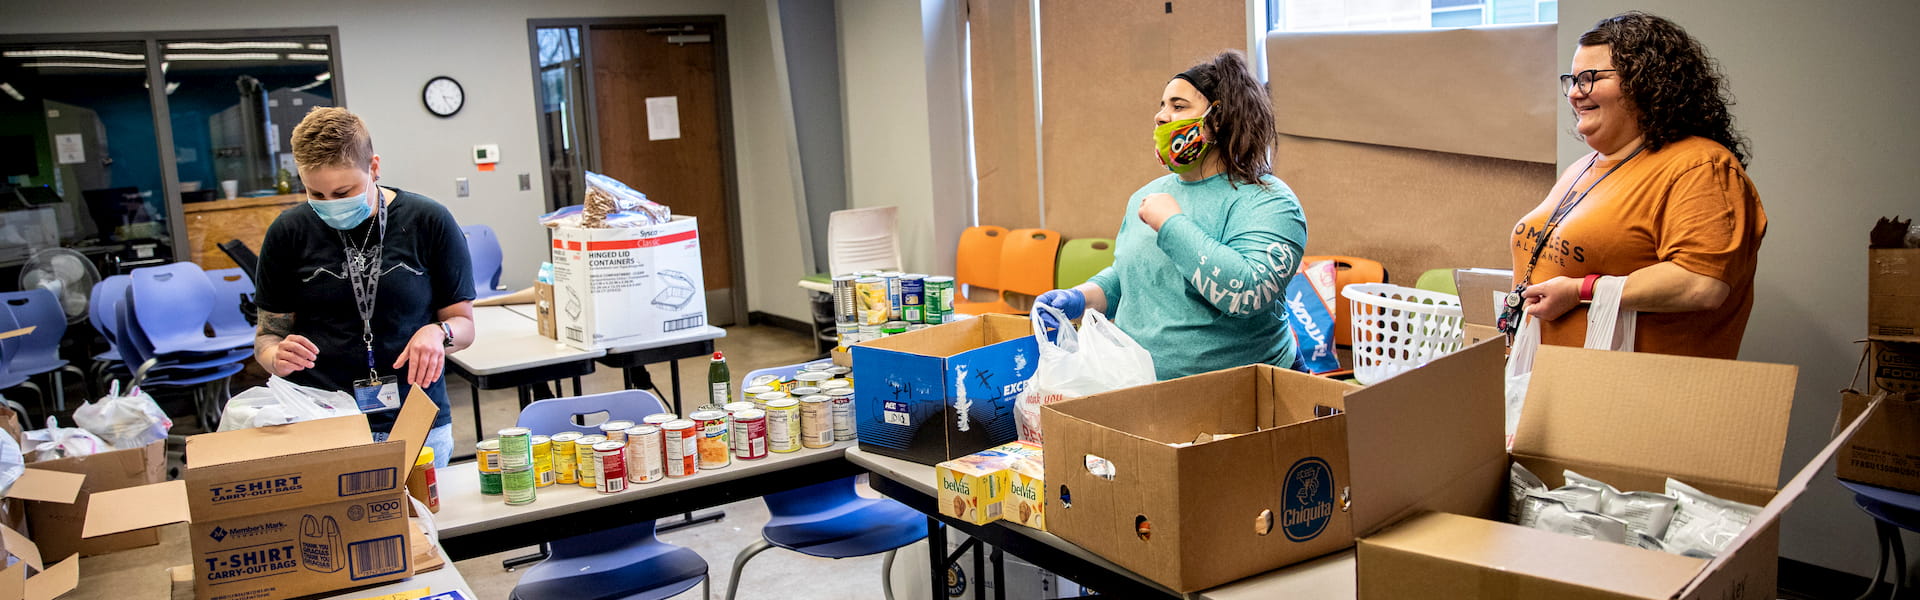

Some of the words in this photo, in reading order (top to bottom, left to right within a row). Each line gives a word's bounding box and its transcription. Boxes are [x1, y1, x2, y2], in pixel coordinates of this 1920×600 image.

[637, 237, 661, 248] Classic
[640, 229, 658, 238] Sysco
[589, 251, 617, 259] HINGED
[618, 250, 630, 258] LID
[589, 258, 635, 267] CONTAINERS
[1516, 240, 1566, 267] ALLANCE
[210, 476, 302, 497] T-SHIRT
[211, 488, 274, 502] CARRY-OUT
[275, 484, 303, 493] BAGS
[943, 477, 970, 496] belVita
[1011, 481, 1036, 501] belVita
[370, 501, 399, 513] 1000
[1283, 501, 1331, 527] Chiquita
[229, 524, 264, 535] Member's
[265, 521, 284, 530] Mark
[205, 545, 295, 572] T-SHIRT
[207, 564, 269, 581] CARRY-OUT
[270, 559, 297, 571] BAGS
